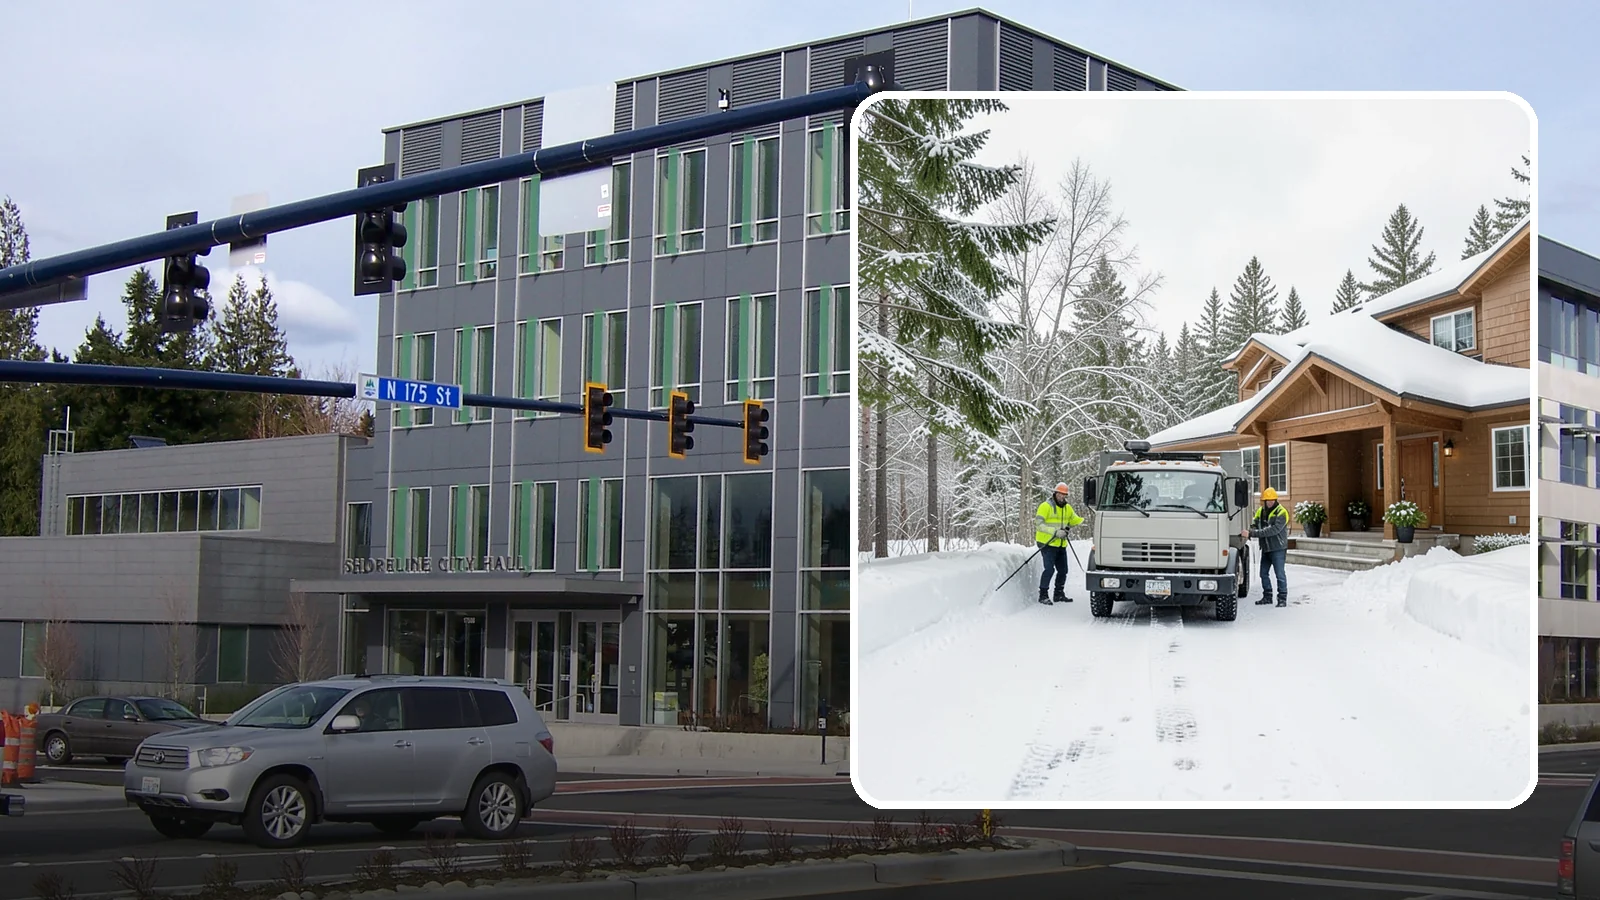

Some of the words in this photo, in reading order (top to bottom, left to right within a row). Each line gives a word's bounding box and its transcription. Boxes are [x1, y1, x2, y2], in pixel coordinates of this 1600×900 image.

[387, 380, 396, 400] N
[405, 382, 427, 403] 175
[436, 386, 451, 406] St
[343, 556, 432, 574] SHORELINE
[438, 555, 476, 572] CITY
[484, 555, 525, 572] HALL
